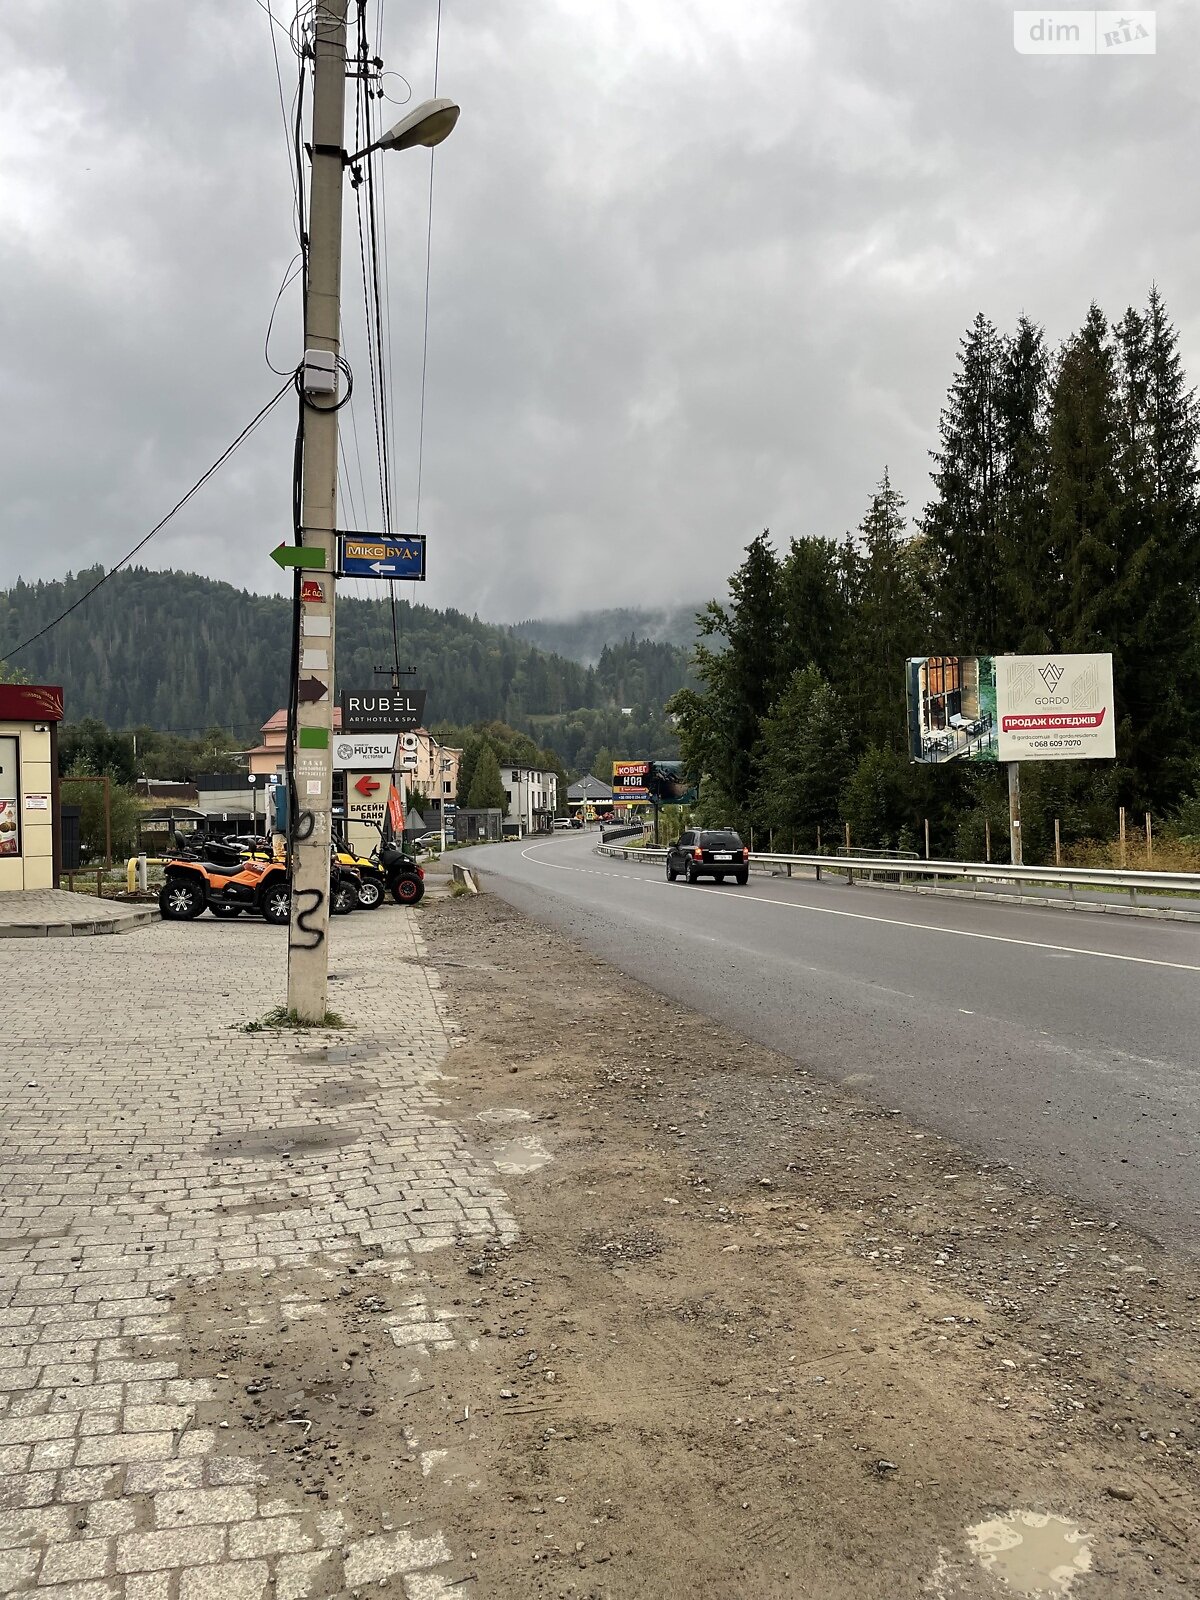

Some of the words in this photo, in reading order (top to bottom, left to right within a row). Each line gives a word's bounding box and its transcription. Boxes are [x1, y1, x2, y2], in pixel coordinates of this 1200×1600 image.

[1034, 696, 1070, 705] GORDO
[1005, 718, 1047, 727] ПРОДАЖ
[1048, 716, 1096, 726] КОТЕДЖІВ
[1034, 740, 1048, 748] 068
[1064, 739, 1082, 747] 7070
[354, 746, 392, 754] HUTSUL
[618, 765, 647, 775] КОВЧЕГ
[623, 776, 643, 786] НОЯ
[350, 803, 385, 812] БАСЕЙН
[360, 812, 383, 820] БАНЯ
